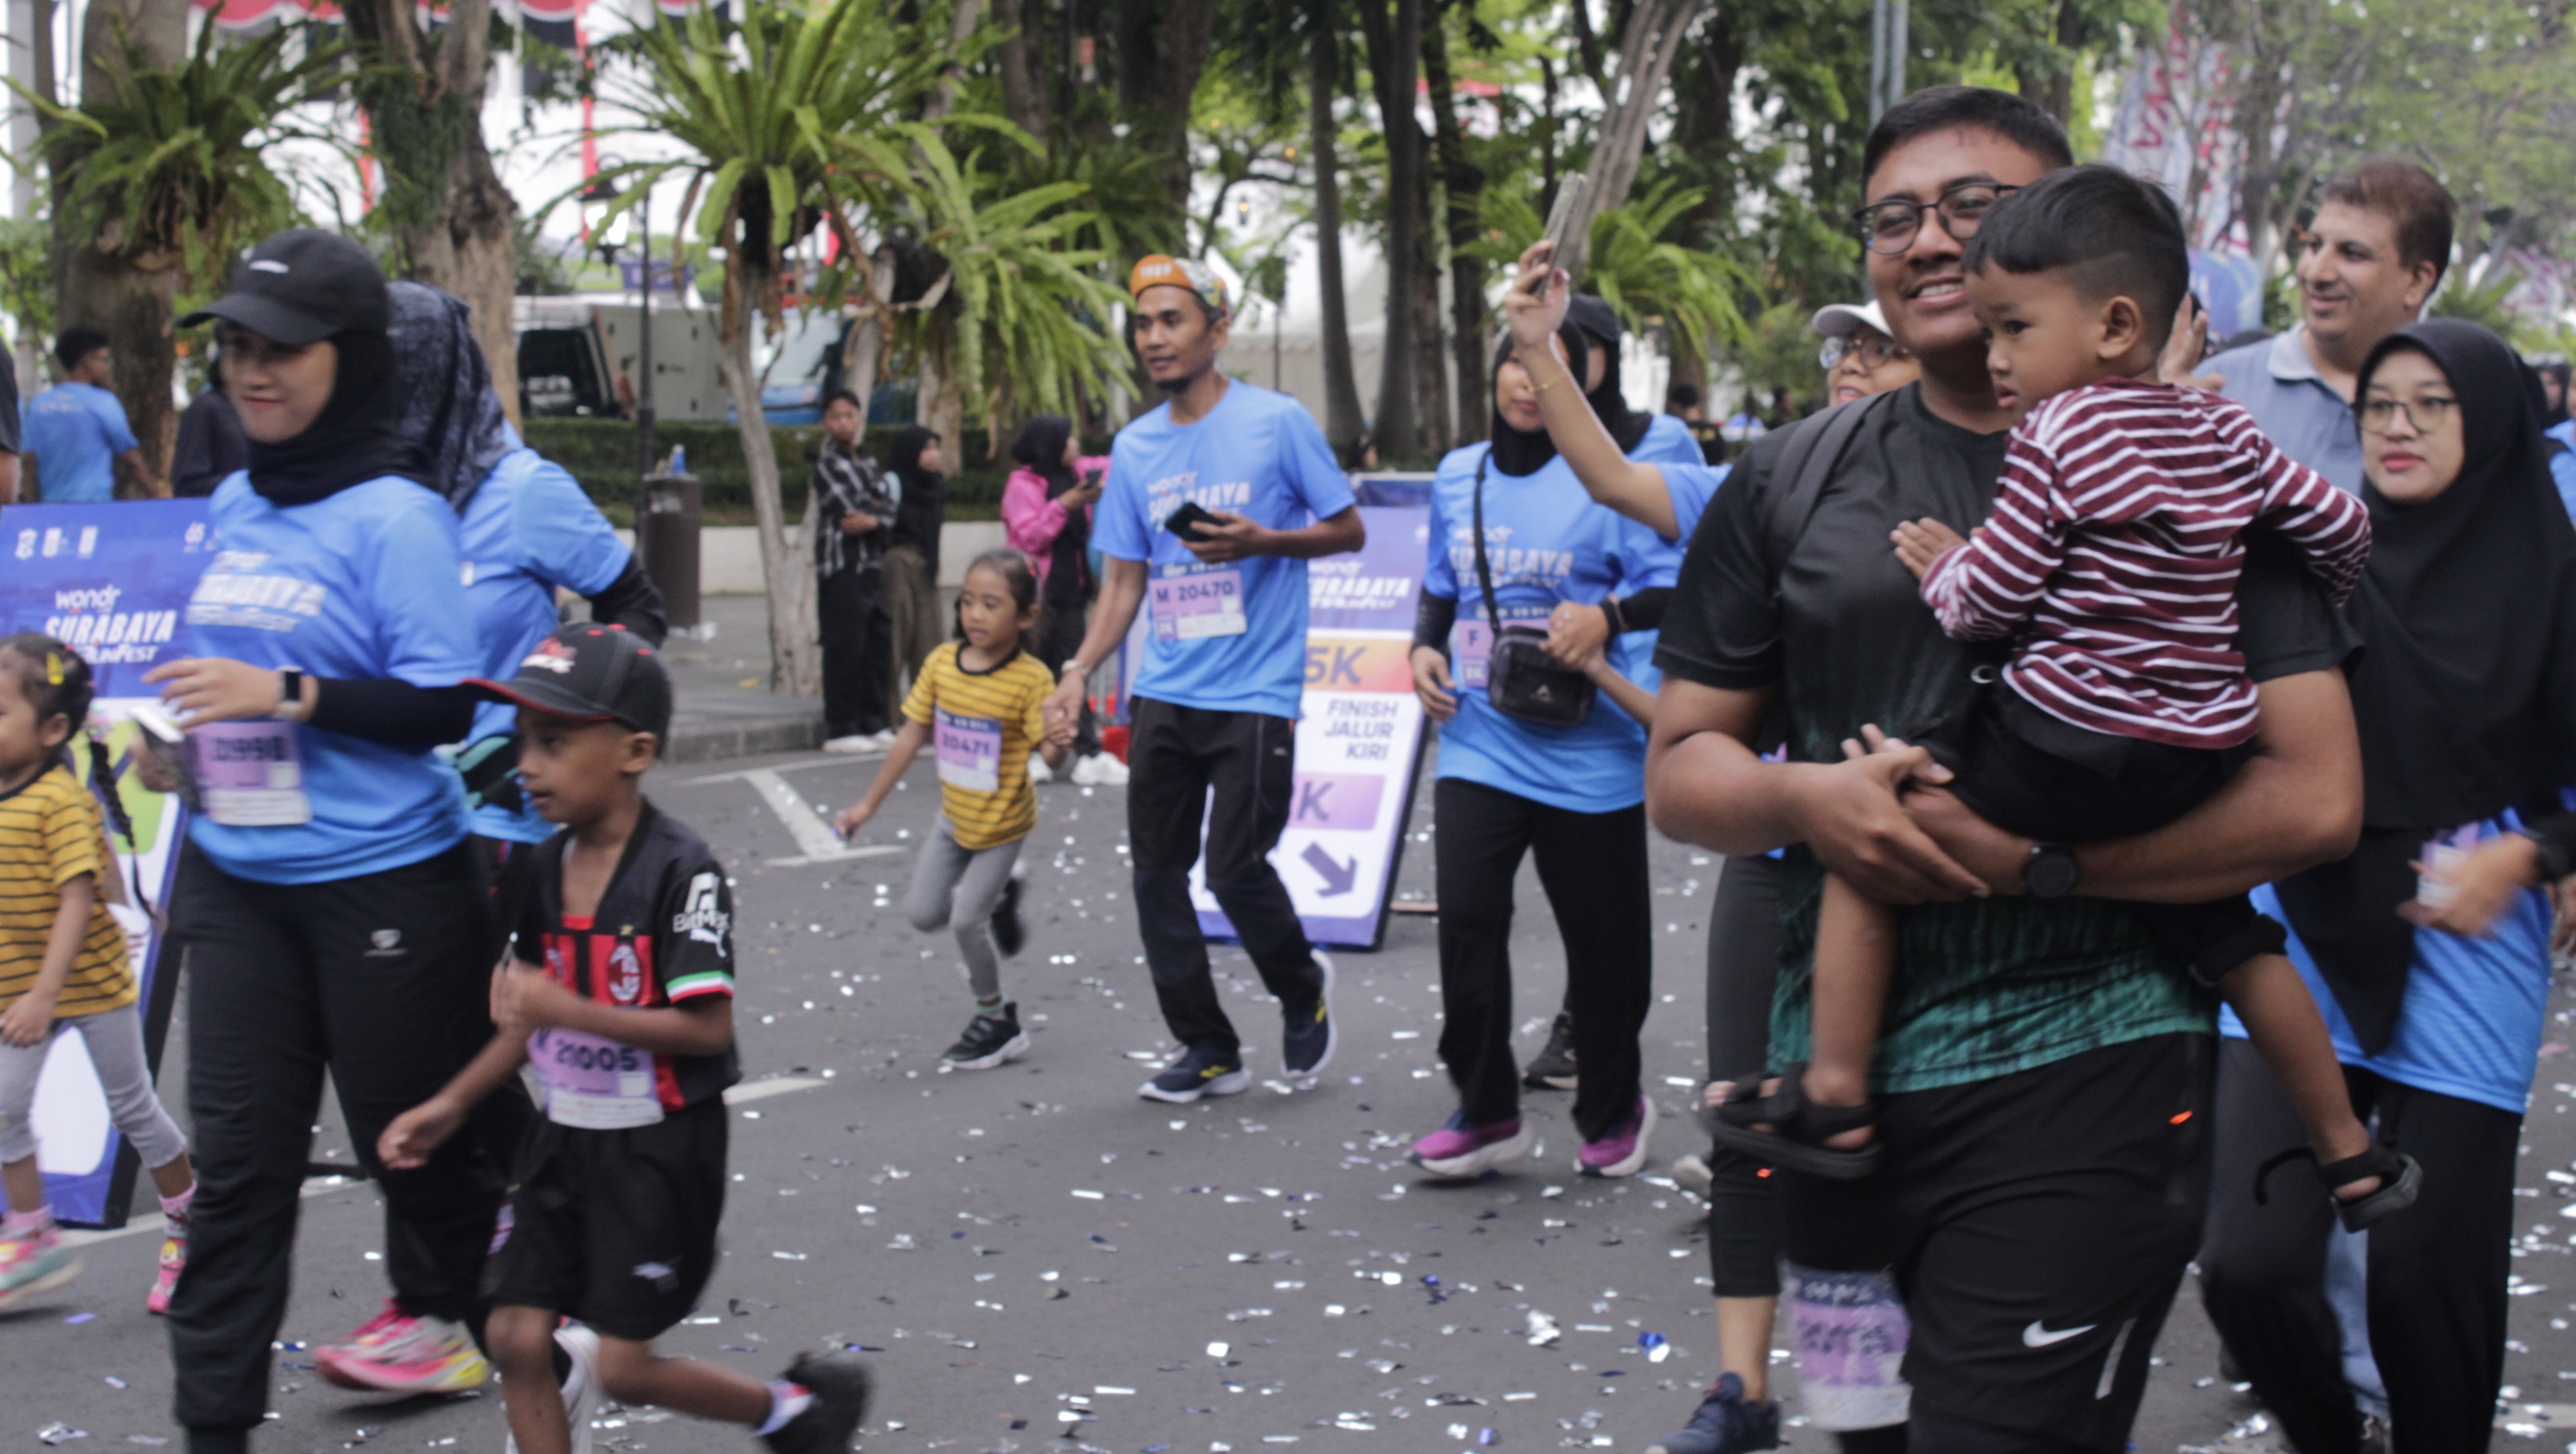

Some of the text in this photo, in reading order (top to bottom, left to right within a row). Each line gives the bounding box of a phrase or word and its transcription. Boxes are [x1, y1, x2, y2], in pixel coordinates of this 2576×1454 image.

[55, 583, 122, 610] wondr
[1178, 581, 1233, 602] 20470
[46, 609, 177, 644] SURABAYA
[1305, 645, 1368, 685] 5K
[1327, 699, 1398, 717] FINISH
[1324, 721, 1394, 739] JALUR
[1346, 743, 1388, 760] KIRI
